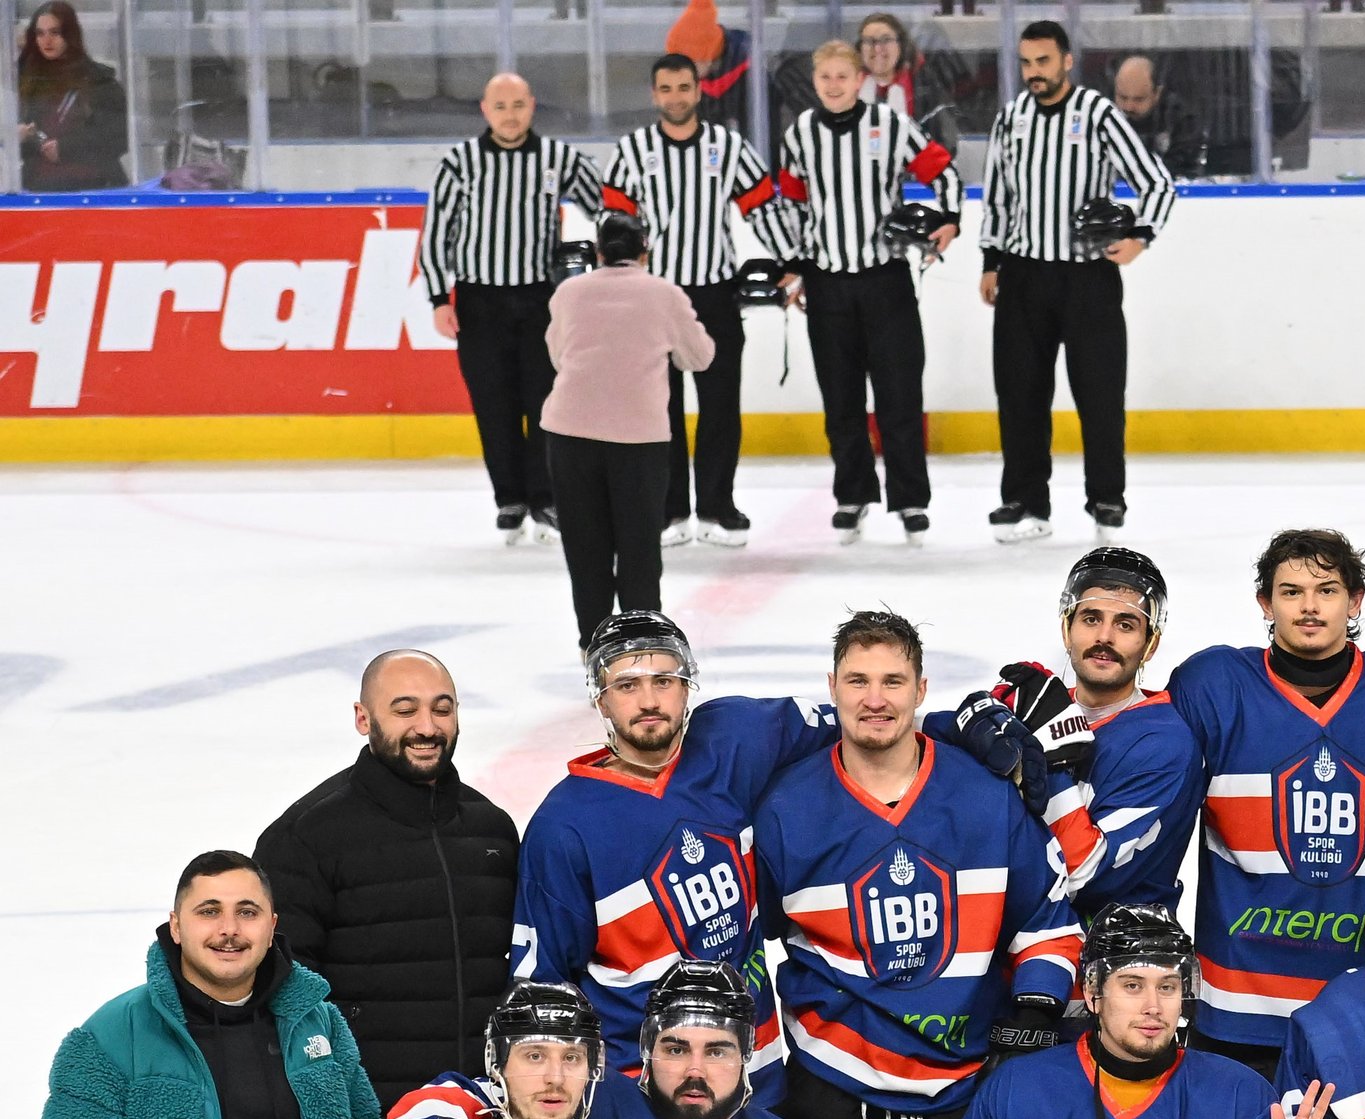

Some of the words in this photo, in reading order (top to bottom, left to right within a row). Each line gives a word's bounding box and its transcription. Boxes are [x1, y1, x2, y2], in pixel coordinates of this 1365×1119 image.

[1308, 836, 1336, 851] SPOR
[705, 913, 734, 934] SPOR
[895, 942, 923, 957] SPOR
[538, 1008, 576, 1020] CCM
